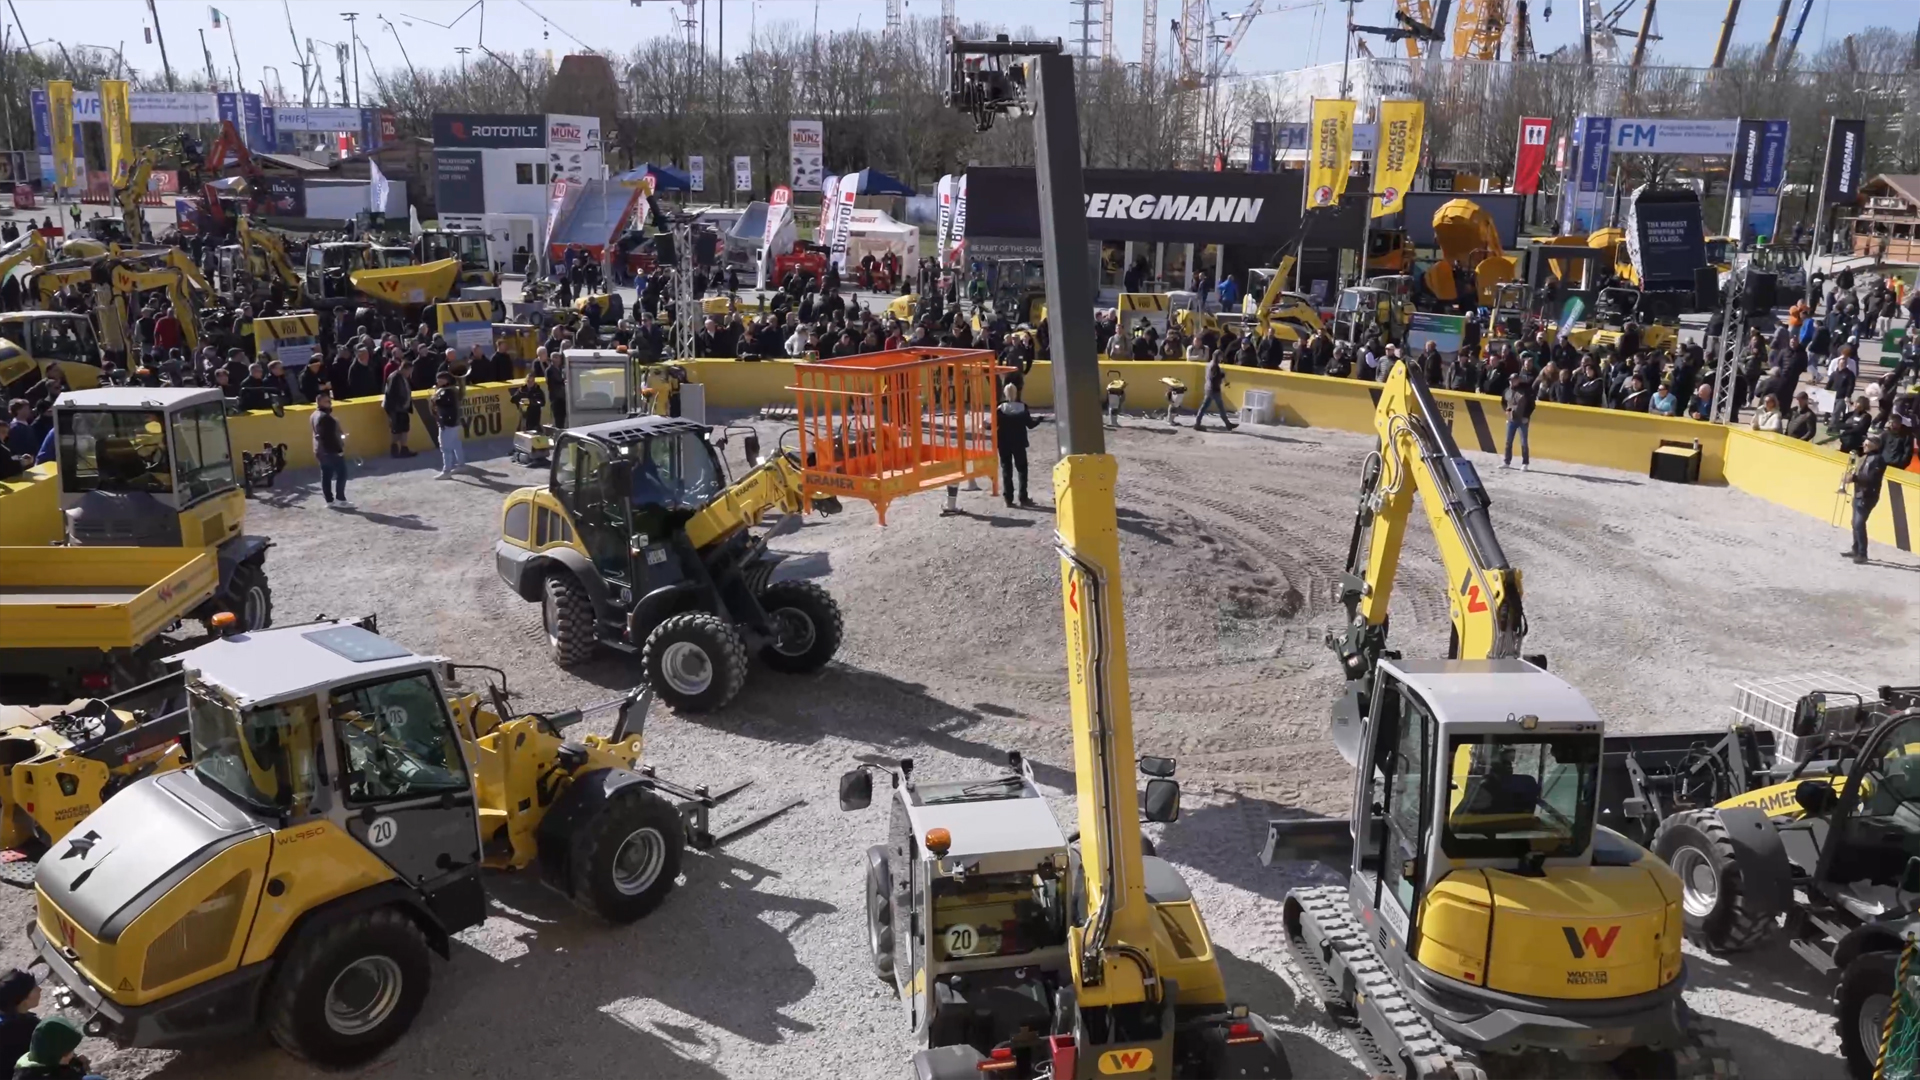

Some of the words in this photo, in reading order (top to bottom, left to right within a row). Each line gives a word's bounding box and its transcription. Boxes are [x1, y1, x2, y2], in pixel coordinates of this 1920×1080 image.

[472, 126, 537, 137] ROTOTILT
[1617, 124, 1656, 147] FM
[1320, 118, 1330, 170] WACKER
[1328, 118, 1338, 169] NEUSON
[1386, 121, 1399, 172] WACKER
[1396, 120, 1407, 172] NEUSON
[1744, 130, 1757, 182] BERGMANN
[1764, 141, 1778, 182] Scaffolding
[1839, 131, 1854, 193] BERGMANN
[462, 395, 500, 405] OLUTIONS
[485, 403, 501, 413] FOR
[461, 412, 502, 439] YOU
[735, 479, 759, 498] KRAMER
[806, 474, 854, 490] KRAMER
[55, 804, 89, 815] WACKER
[55, 808, 91, 821] NEUSON
[278, 827, 325, 846] WL950
[374, 820, 392, 843] 20
[951, 929, 972, 951] 20
[1562, 926, 1621, 958] W
[1109, 1052, 1143, 1070] W
